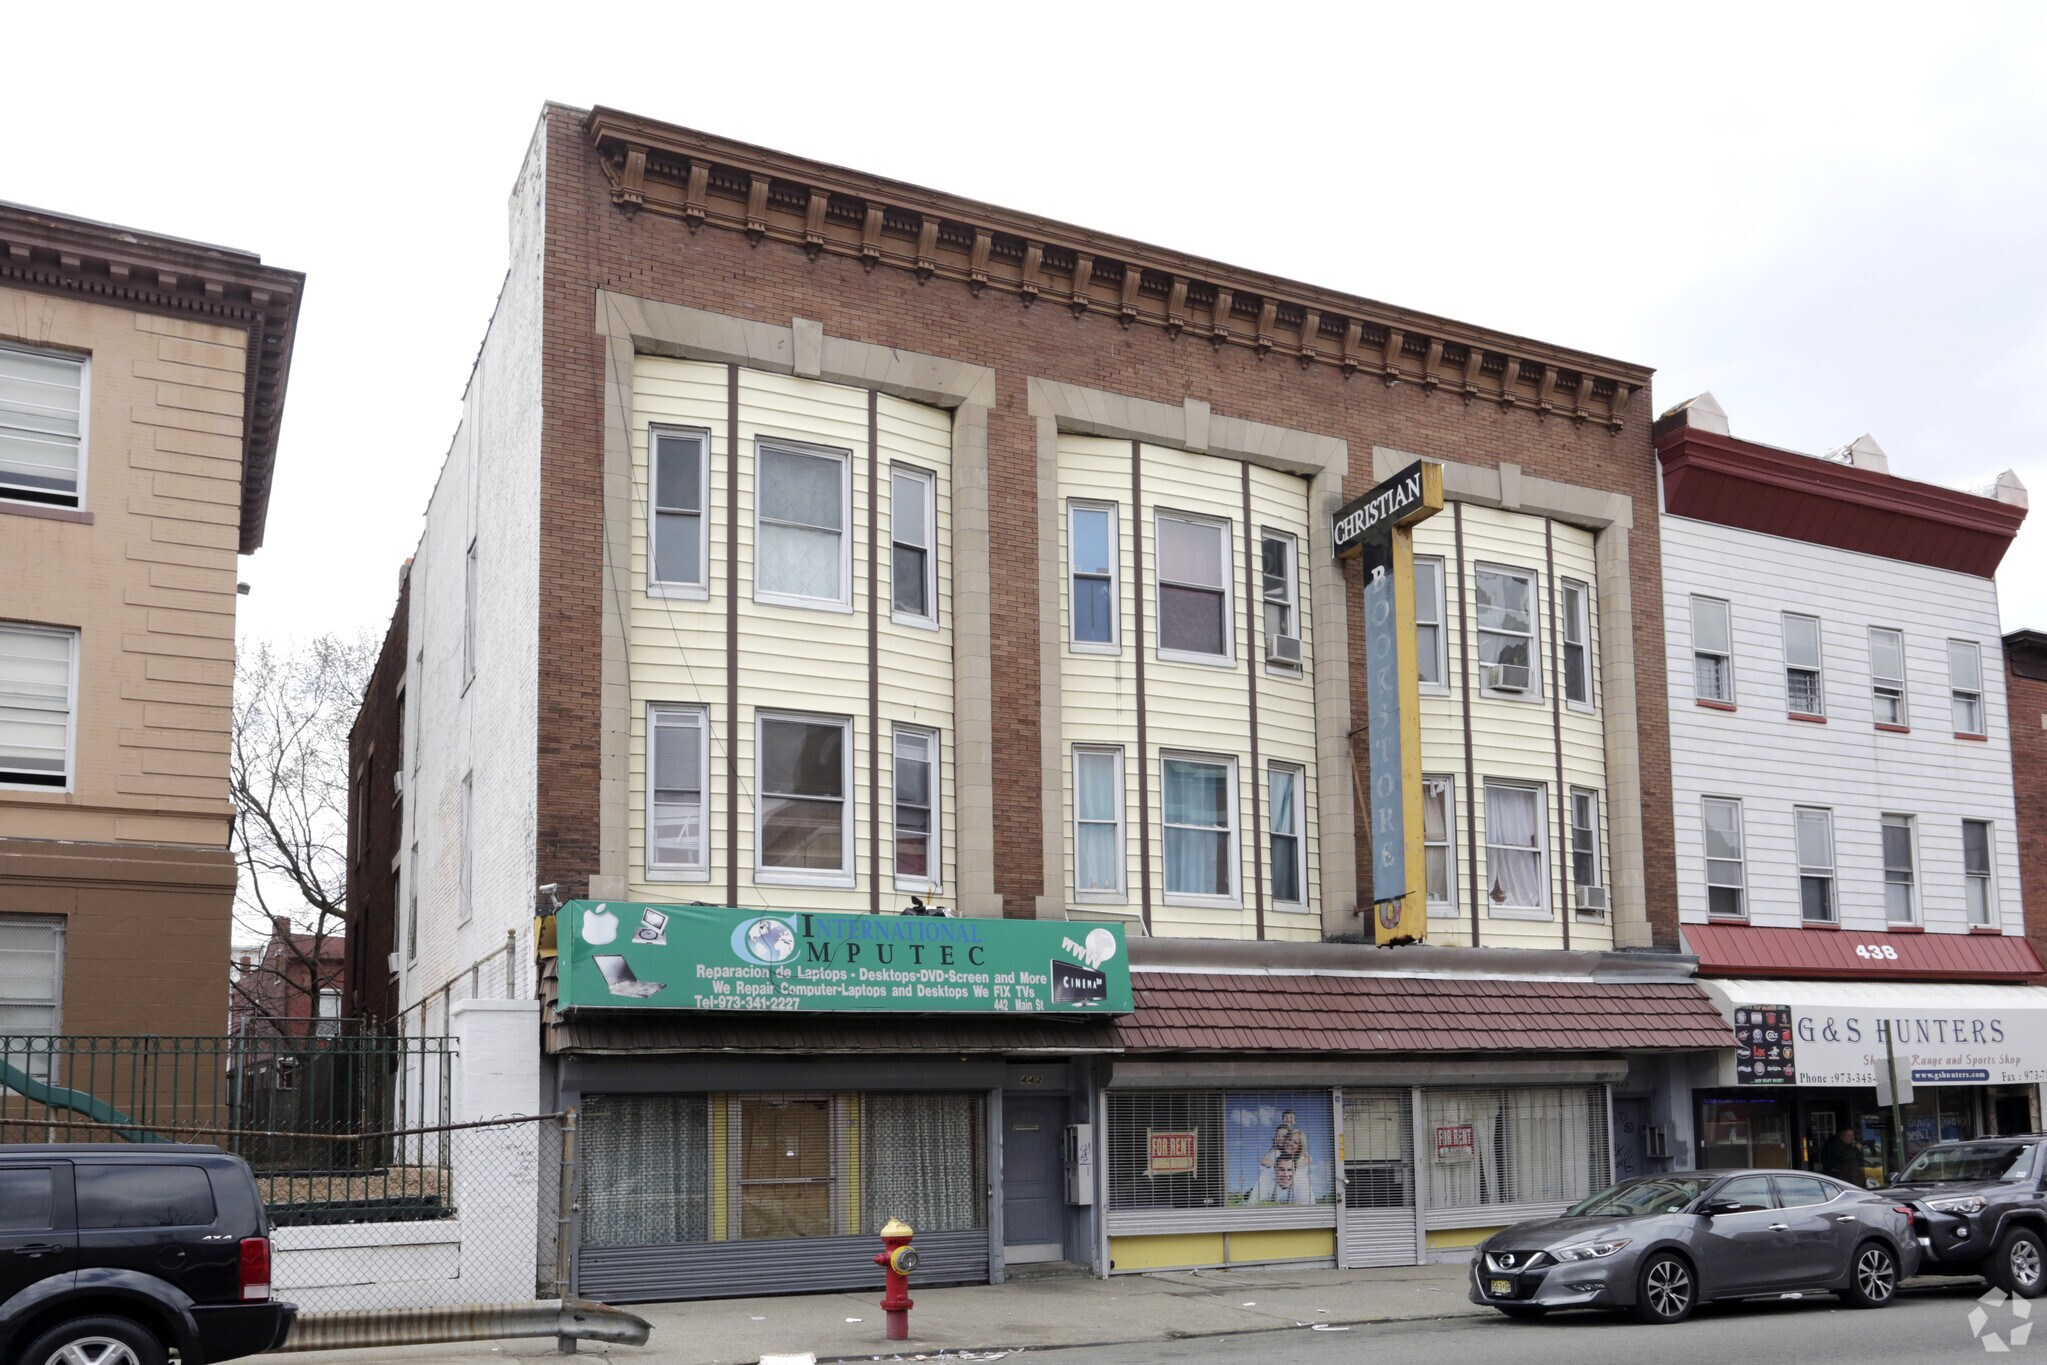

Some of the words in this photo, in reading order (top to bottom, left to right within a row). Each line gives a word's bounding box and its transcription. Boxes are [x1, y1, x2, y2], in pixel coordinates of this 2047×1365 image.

[1334, 472, 1420, 545] CHRISTIAN
[1371, 565, 1396, 868] BOOKSTORE
[802, 914, 982, 942] INTERNATIONAL
[1856, 945, 1898, 960] 438
[696, 964, 770, 981] Reparacion
[776, 966, 792, 979] de
[797, 965, 847, 982] Laptops
[994, 972, 1015, 984] and
[1020, 972, 1047, 984] More
[712, 980, 730, 994] We
[736, 981, 775, 996] Repair
[892, 984, 912, 997] and
[917, 985, 968, 999] Desktops
[972, 985, 989, 998] We
[994, 985, 1011, 998] FIX
[1015, 986, 1035, 998] TVs
[994, 999, 1008, 1011] 442
[1015, 999, 1033, 1011] Main
[1035, 999, 1044, 1011] St
[1875, 1018, 2004, 1044] HUNTERS
[1911, 1054, 1942, 1067] Range
[1946, 1054, 1962, 1065] and
[1966, 1054, 1995, 1067] Sports
[1999, 1053, 2021, 1067] Shop
[1020, 1075, 1042, 1084] 442
[1799, 1073, 1827, 1083] Phone
[1914, 1071, 1986, 1080] www.gshunters.com
[2002, 1072, 2016, 1081] Fax
[1440, 1129, 1452, 1145] FOR
[1453, 1128, 1470, 1144] RENT
[1153, 1138, 1168, 1156] FOR
[1170, 1138, 1192, 1156] RENT
